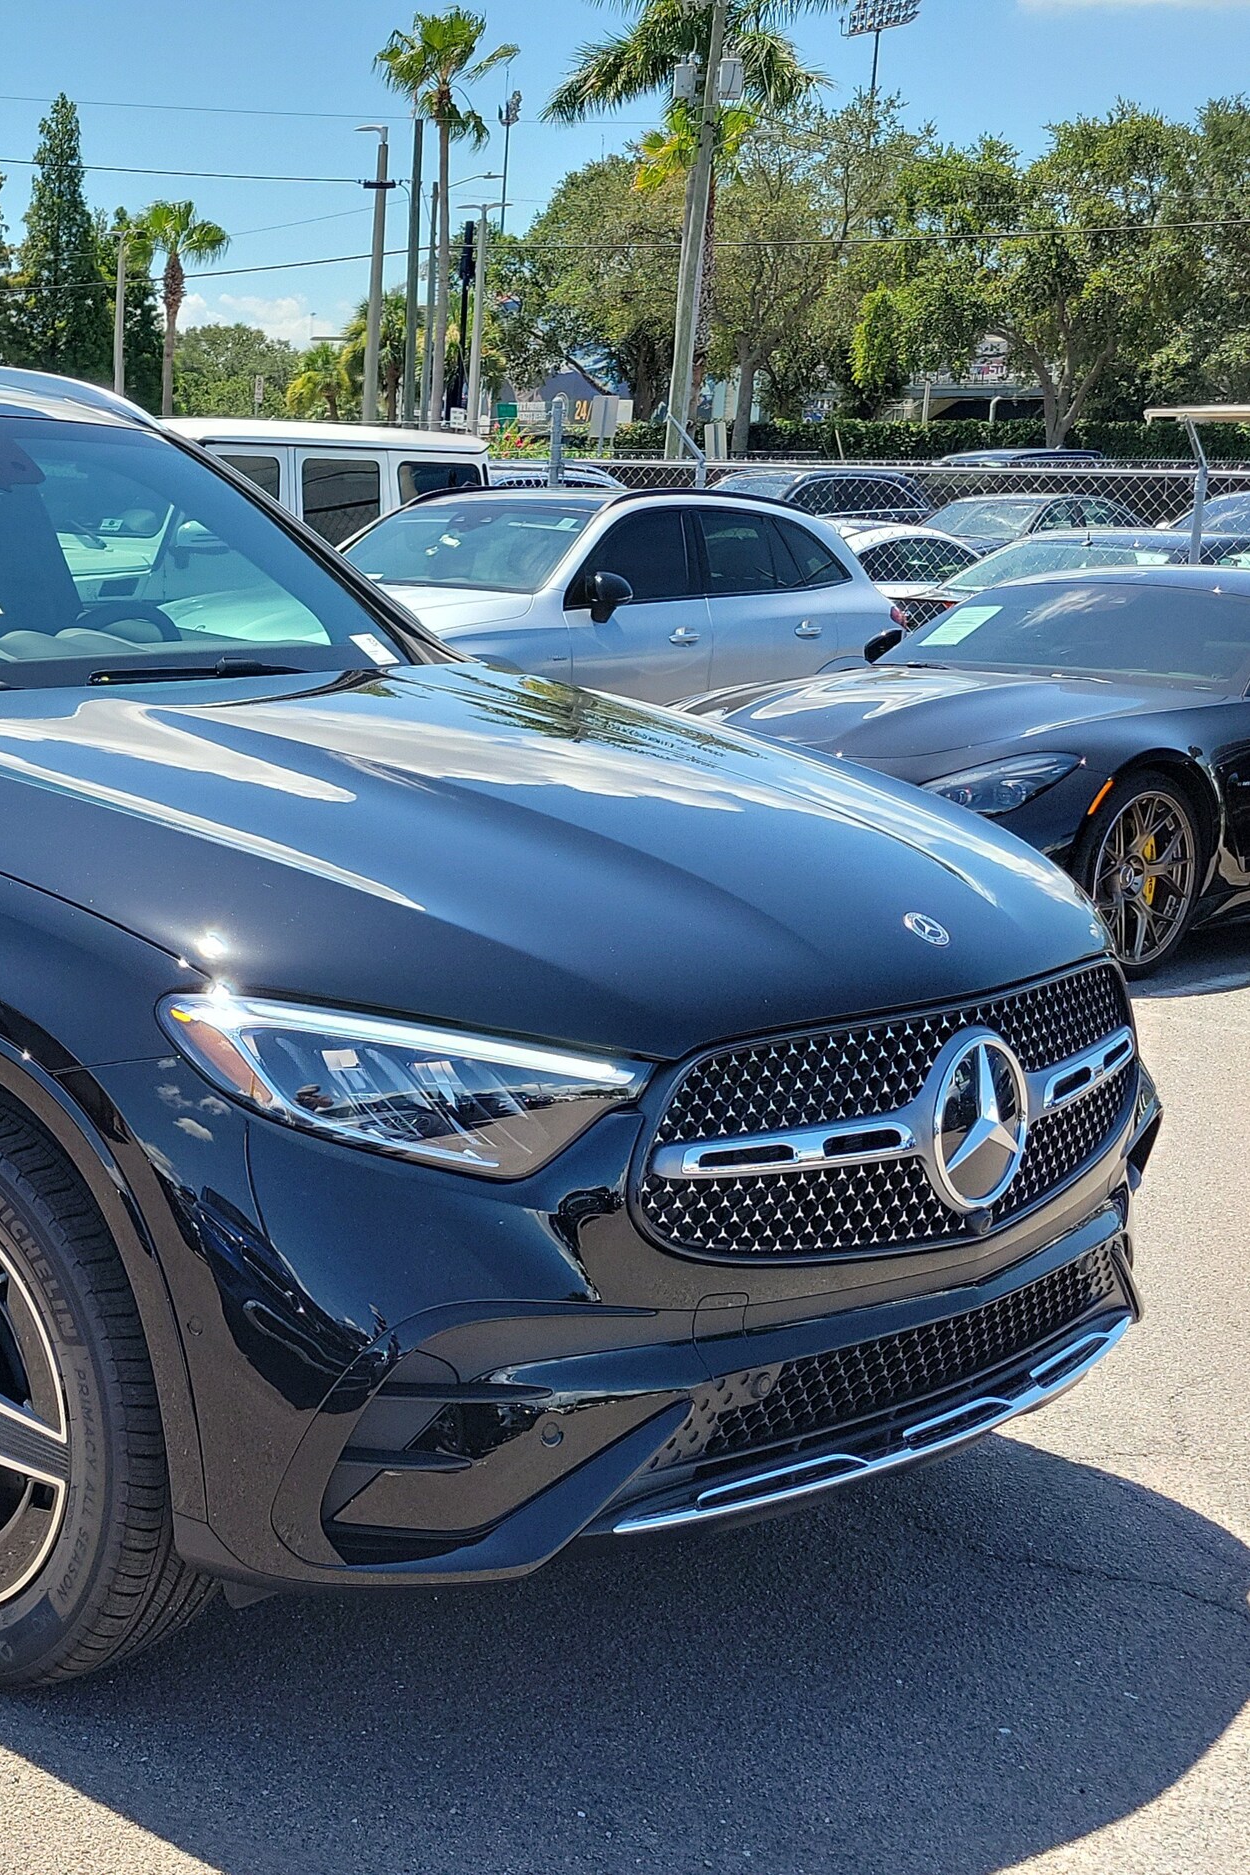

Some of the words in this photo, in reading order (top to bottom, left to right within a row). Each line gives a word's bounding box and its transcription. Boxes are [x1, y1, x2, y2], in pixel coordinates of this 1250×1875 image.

[73, 1367, 98, 1469] PRIMACY
[81, 1478, 96, 1518] ALL
[57, 1526, 91, 1605] SEASON
